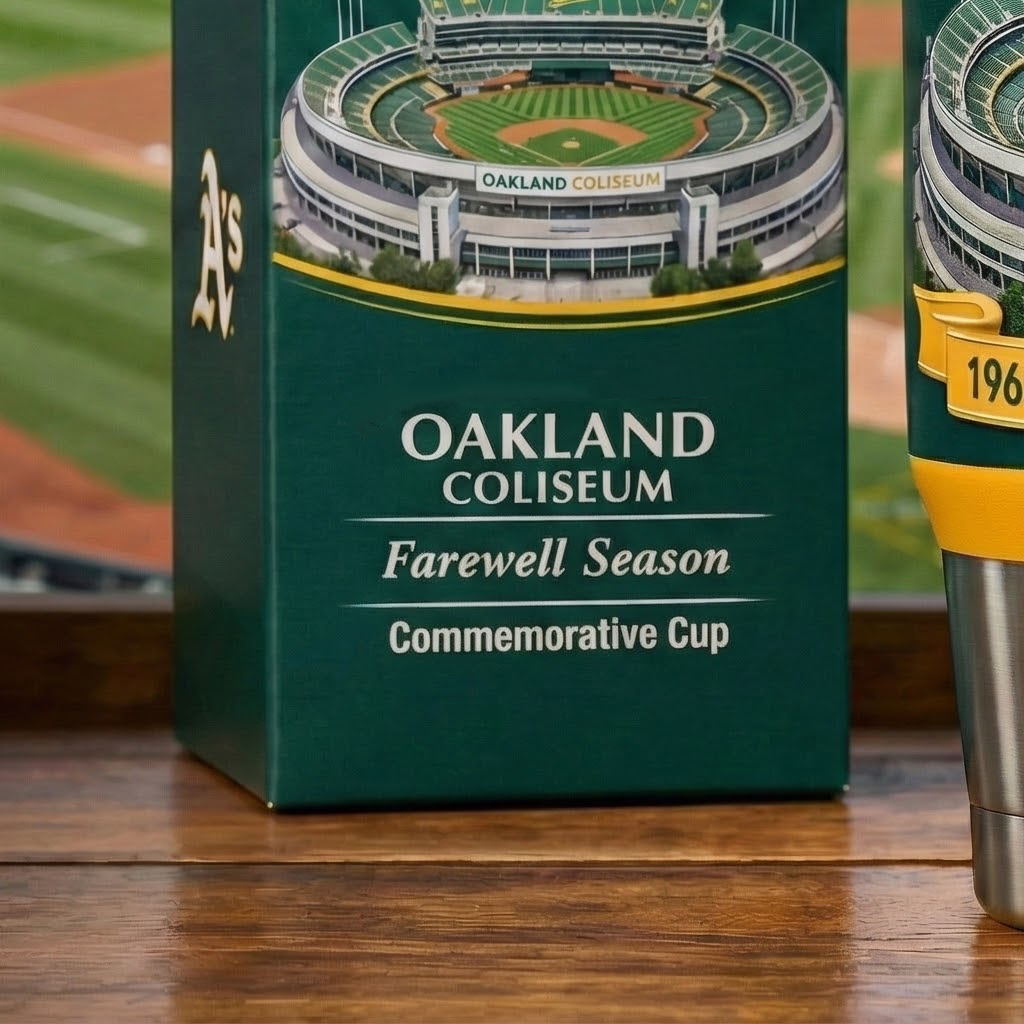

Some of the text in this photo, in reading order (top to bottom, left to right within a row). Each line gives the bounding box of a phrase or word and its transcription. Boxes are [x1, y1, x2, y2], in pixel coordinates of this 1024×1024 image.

[482, 171, 661, 191] OAKLAND COLISEUM
[191, 147, 244, 340] A's
[400, 411, 716, 461] OAKLAND
[442, 469, 674, 505] COLISEUM
[381, 537, 731, 579] Farewell Season
[389, 616, 730, 655] Commemorative Cup
